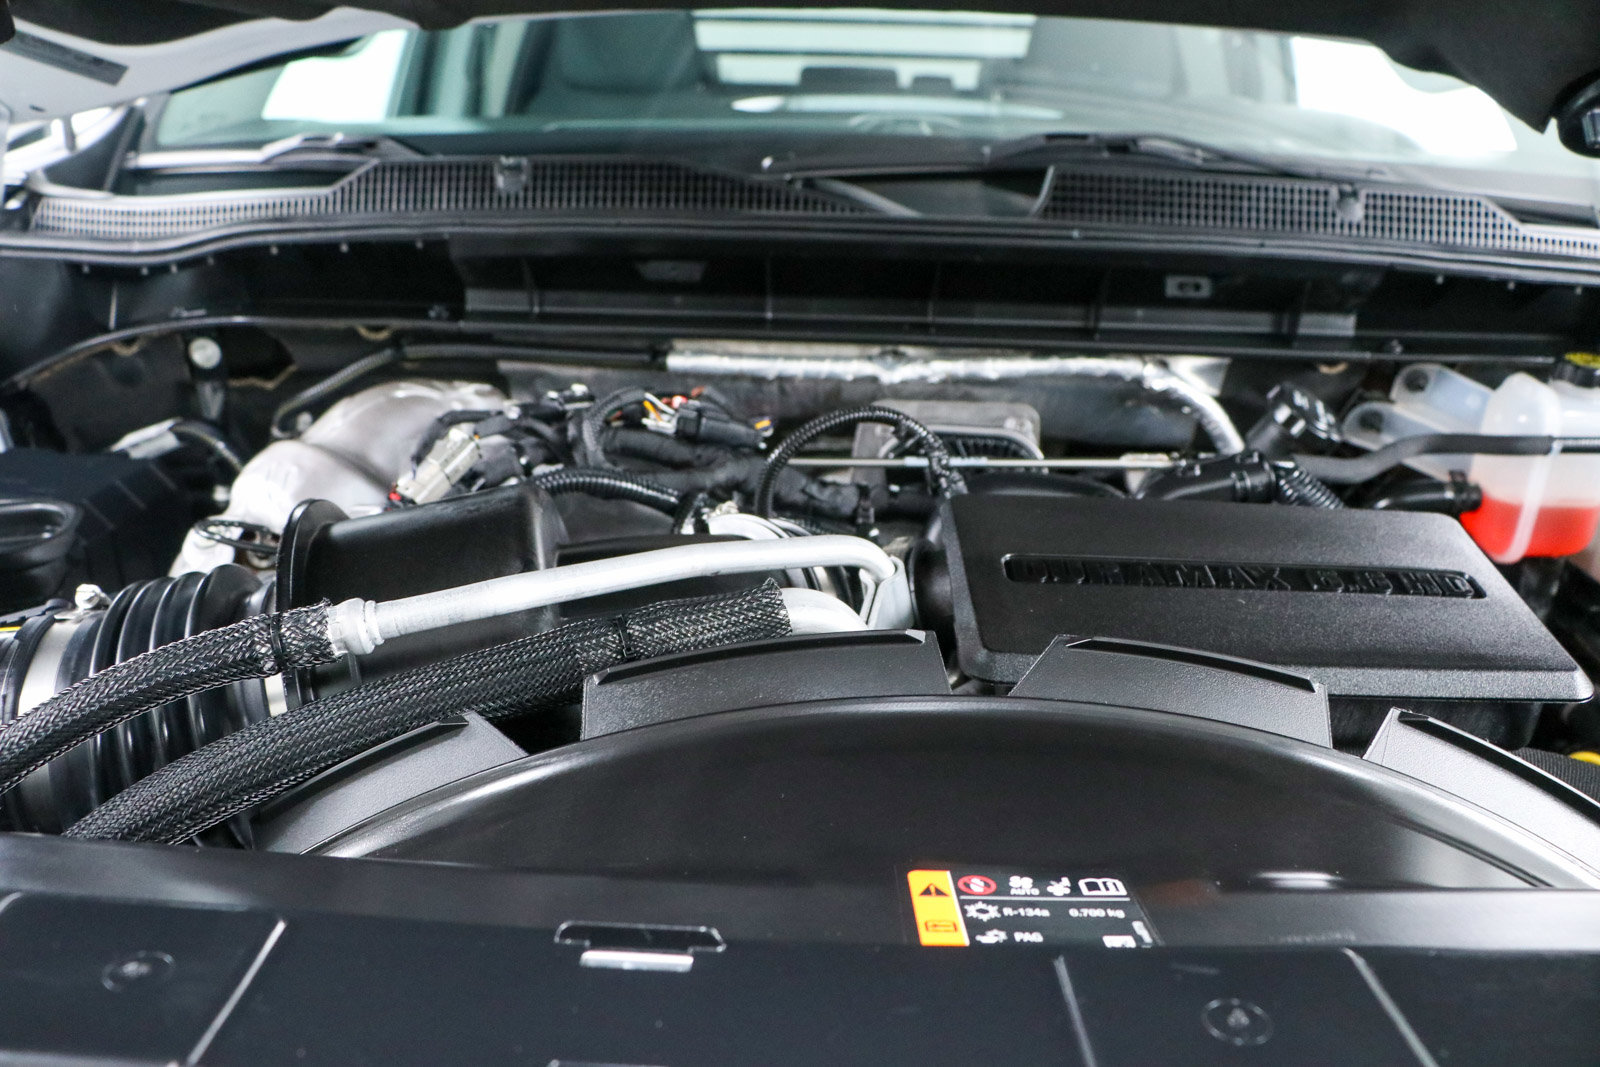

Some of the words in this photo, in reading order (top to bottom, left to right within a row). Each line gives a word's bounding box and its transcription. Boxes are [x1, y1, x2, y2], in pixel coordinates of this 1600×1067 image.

[1019, 558, 1290, 592] DURAMAX
[1308, 567, 1392, 595] 6.6
[1404, 570, 1474, 599] HD
[1010, 888, 1040, 896] AUTO
[1003, 907, 1050, 917] R-134a
[1106, 908, 1126, 919] kg
[1014, 931, 1044, 943] PAG
